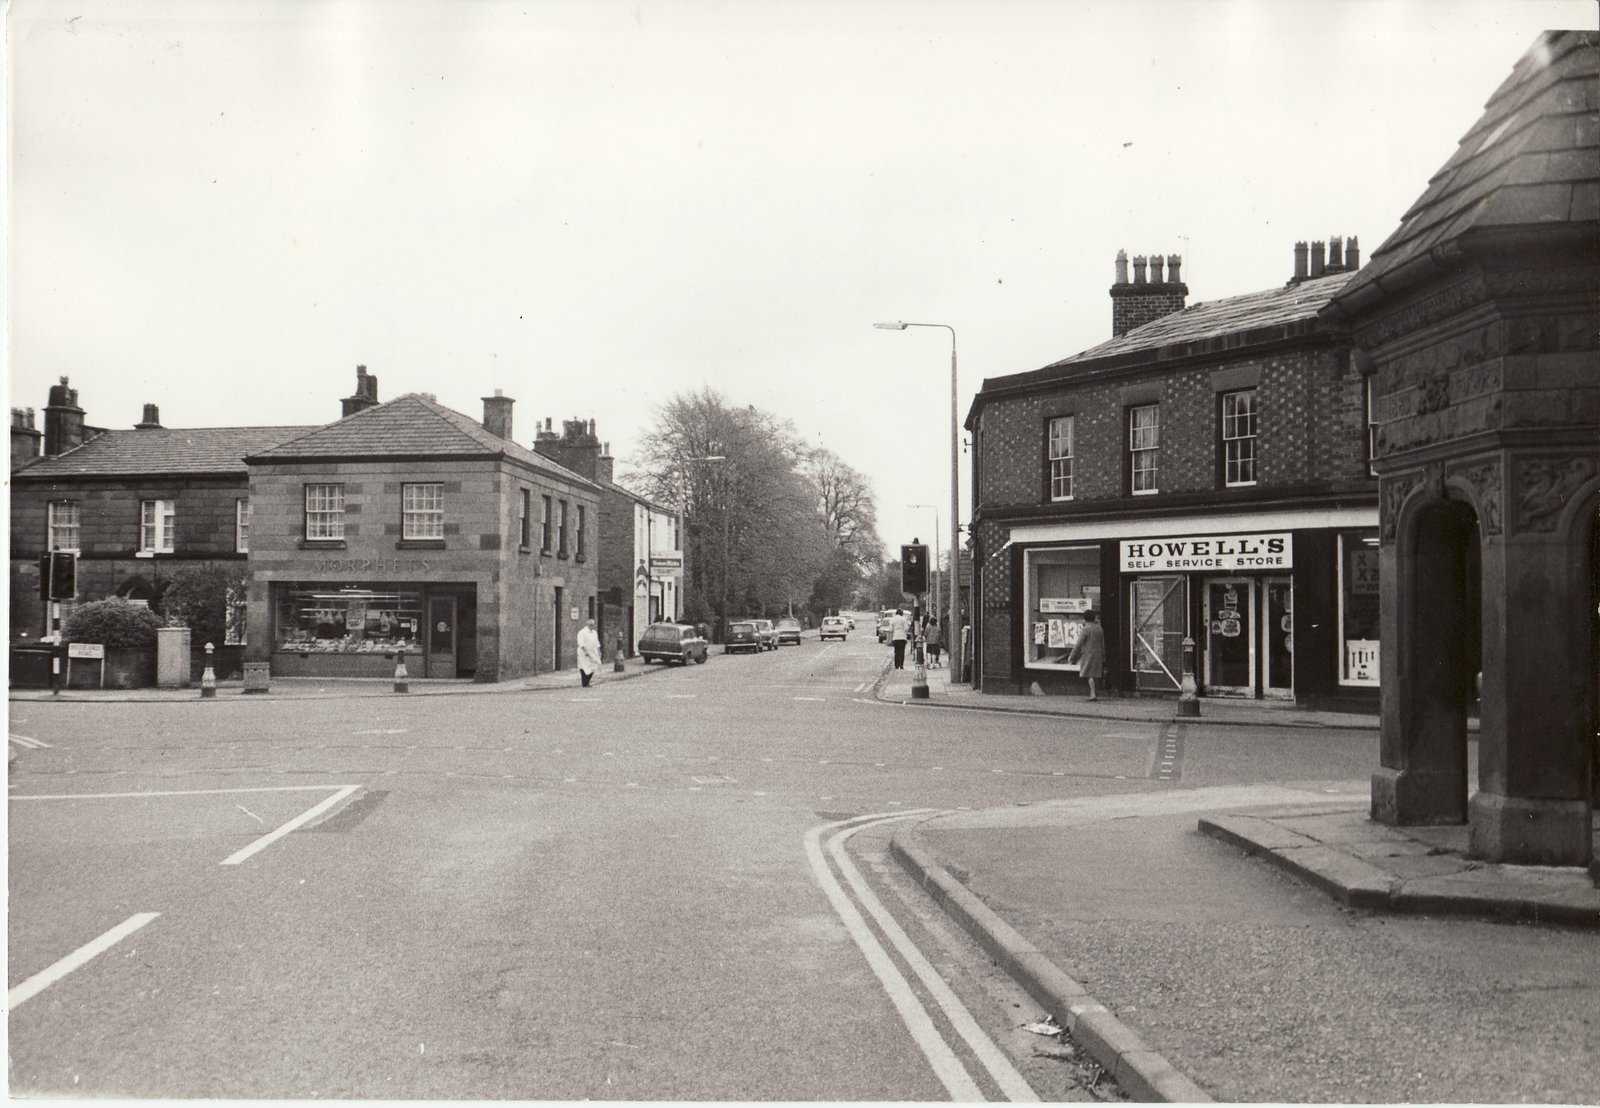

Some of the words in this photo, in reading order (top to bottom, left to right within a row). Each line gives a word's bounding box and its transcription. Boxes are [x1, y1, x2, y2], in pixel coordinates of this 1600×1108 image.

[1127, 538, 1284, 558] HOWELL'S
[1127, 560, 1156, 569] SELF
[1166, 558, 1223, 567] SERVICE
[1236, 556, 1283, 566] STORE
